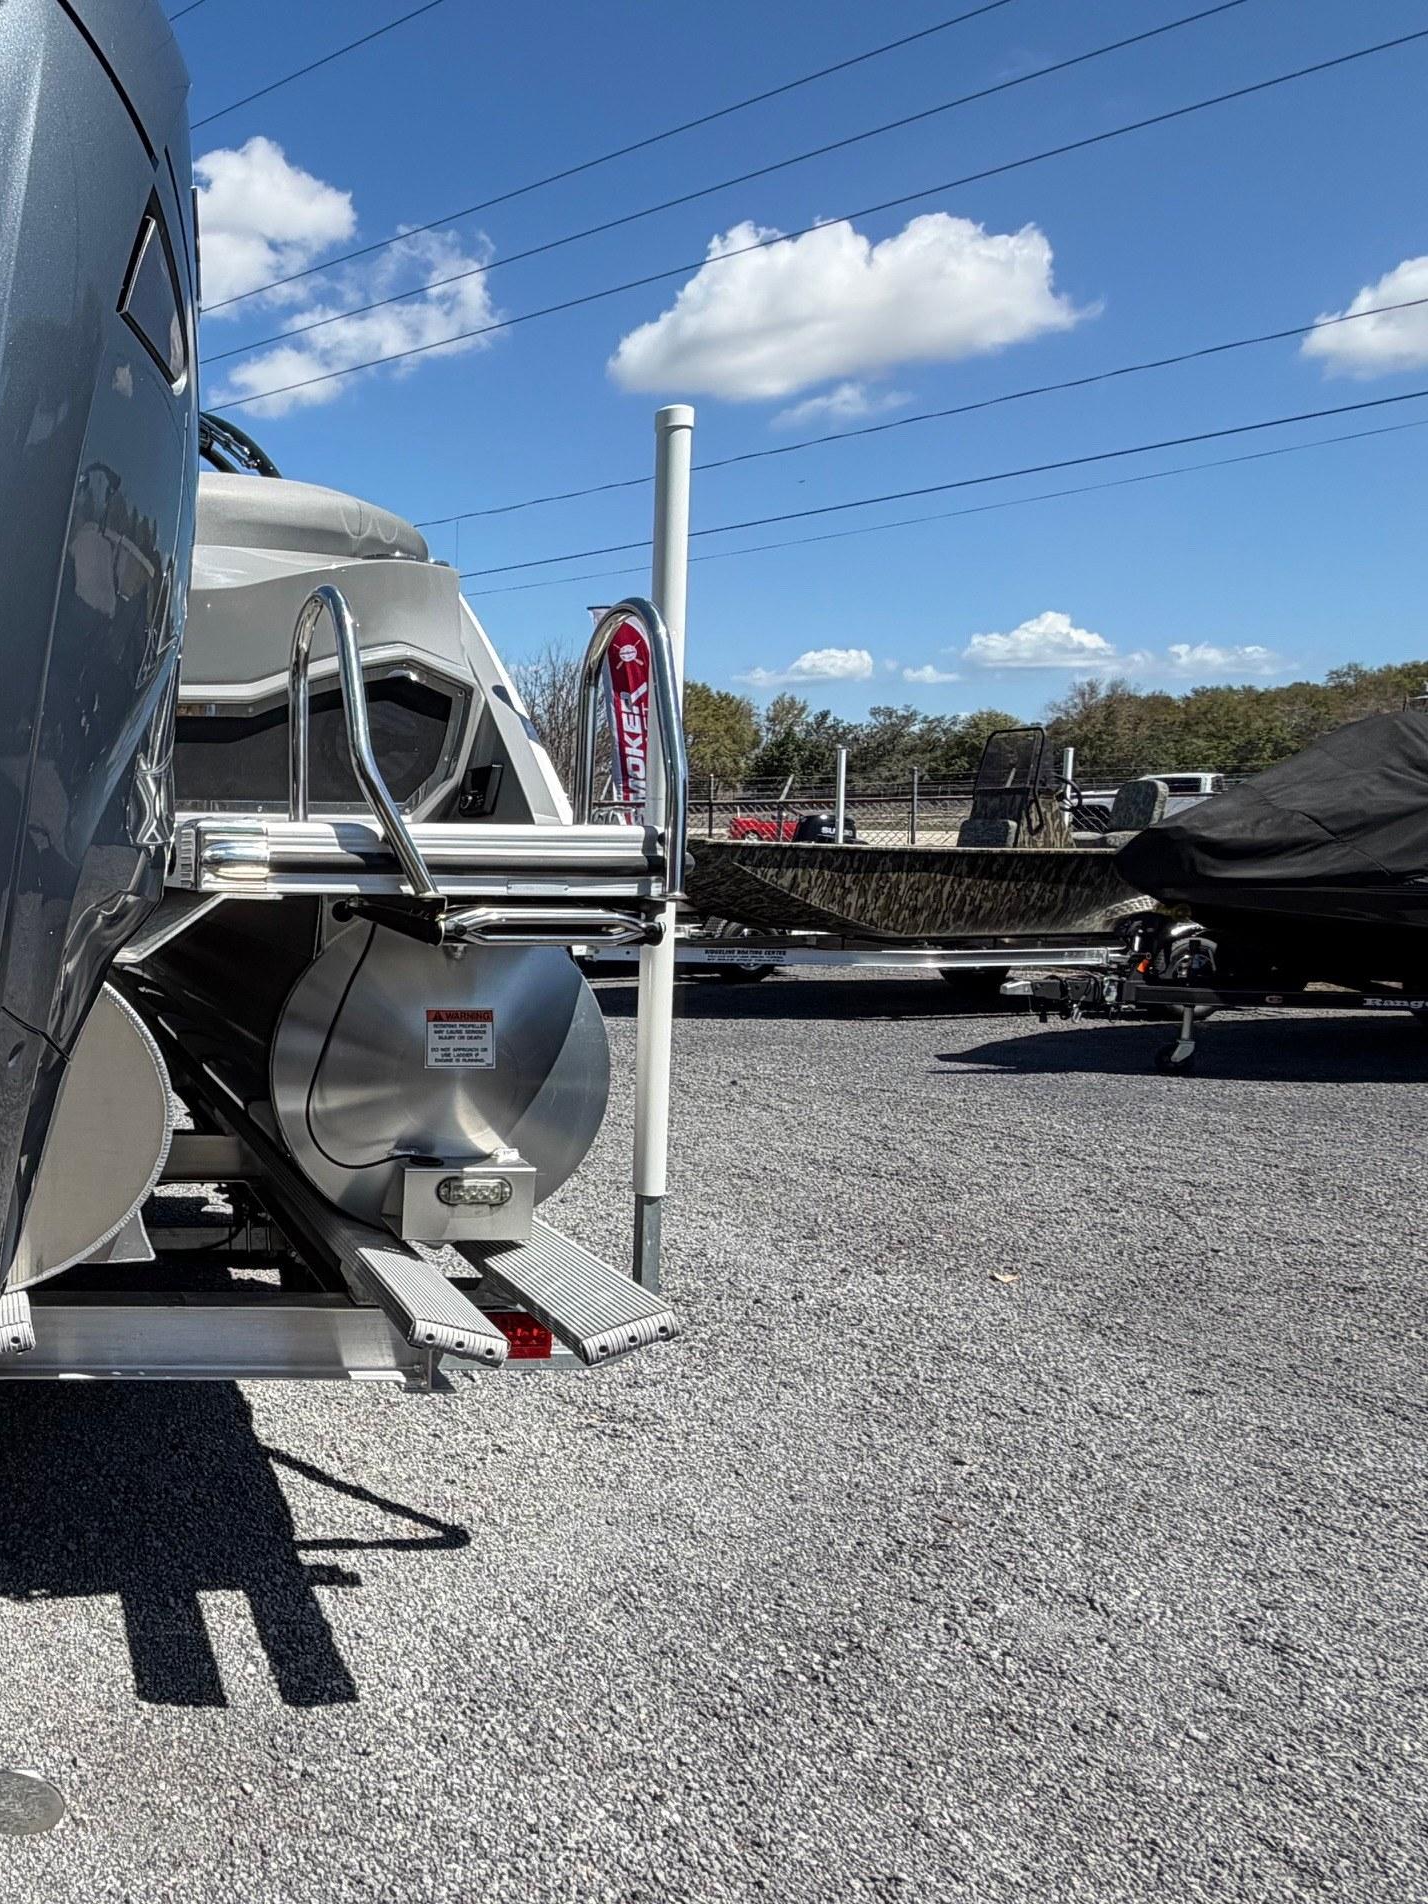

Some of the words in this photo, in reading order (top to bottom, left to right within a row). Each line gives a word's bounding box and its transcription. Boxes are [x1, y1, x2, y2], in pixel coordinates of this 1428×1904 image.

[619, 682, 648, 824] MOKER
[1363, 998, 1428, 1009] Rang
[445, 1011, 492, 1021] WARNING
